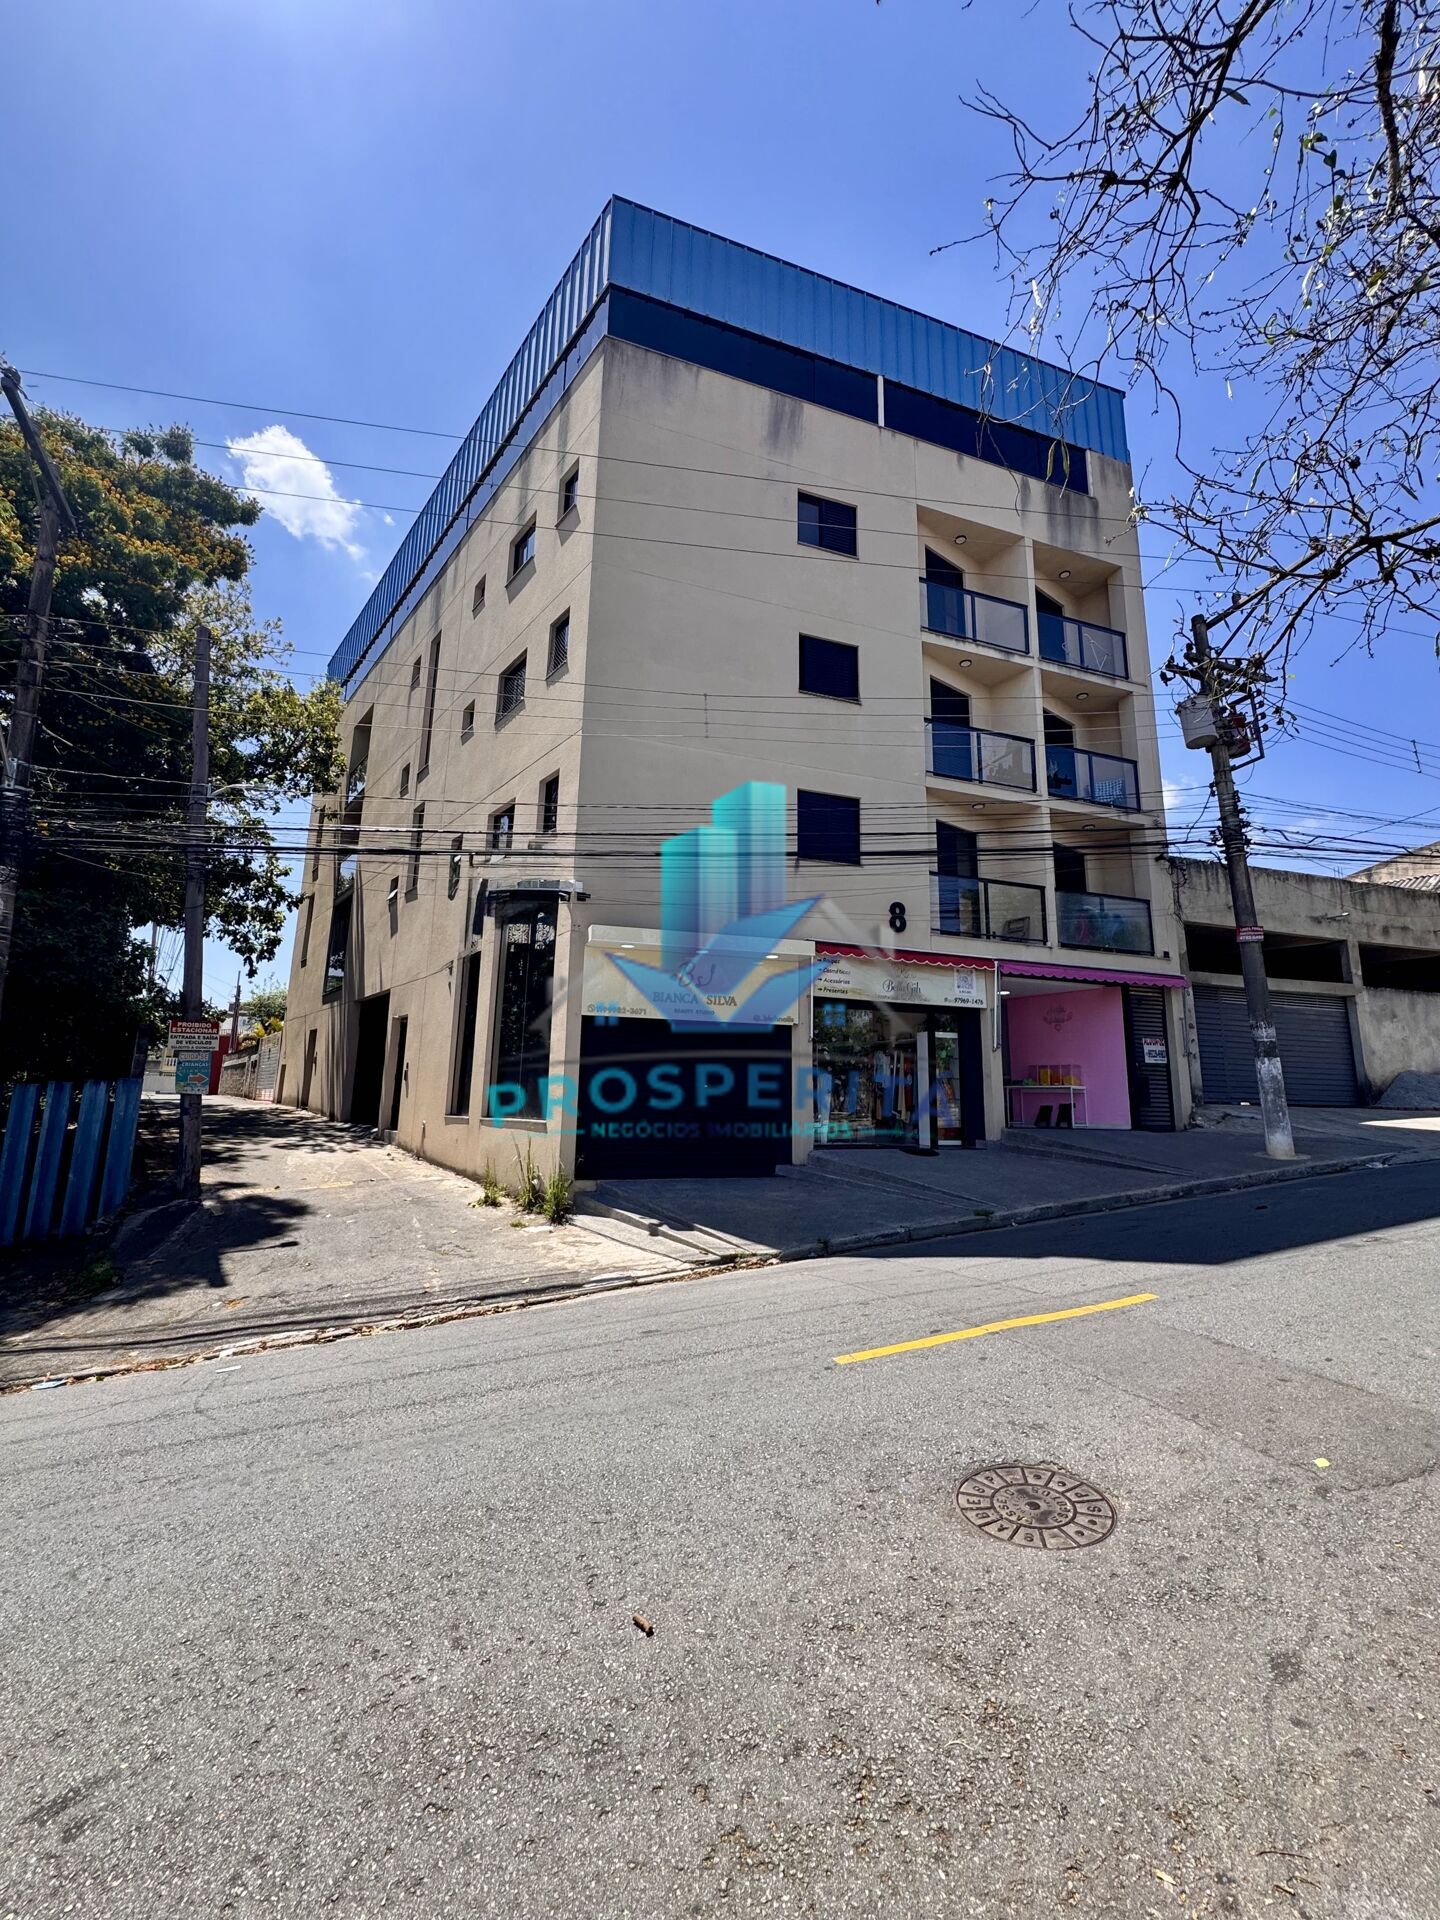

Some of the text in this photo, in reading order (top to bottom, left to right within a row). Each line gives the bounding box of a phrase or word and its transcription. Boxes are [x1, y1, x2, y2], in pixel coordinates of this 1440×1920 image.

[888, 901, 907, 933] 8
[653, 991, 738, 1006] BIANCA SILVA
[823, 987, 848, 995] Presentes
